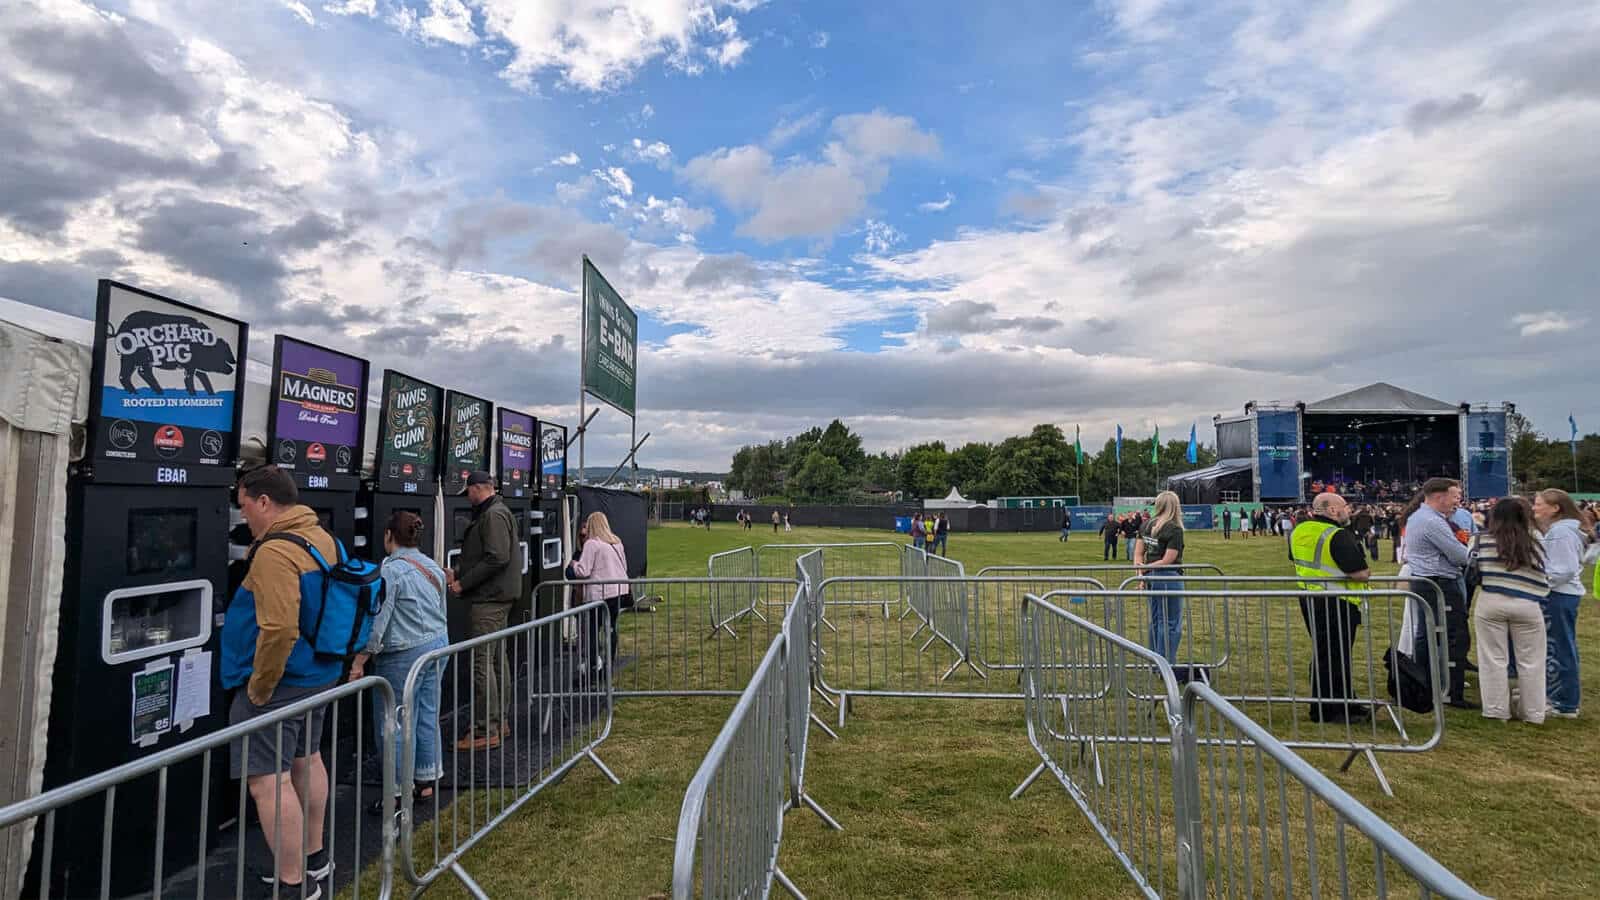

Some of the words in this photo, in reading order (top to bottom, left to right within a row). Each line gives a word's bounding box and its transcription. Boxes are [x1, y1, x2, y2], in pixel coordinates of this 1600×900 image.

[116, 324, 217, 355] ORCHARD
[600, 314, 633, 369] E-BAR
[150, 343, 192, 366] PIG
[124, 398, 165, 407] ROOTED
[167, 398, 177, 407] IN
[178, 398, 224, 407] SOMERSET
[283, 377, 355, 408] MAGNERS
[397, 388, 427, 409] INNIS
[407, 410, 416, 426] &
[457, 403, 480, 423] INNIS
[394, 427, 425, 449] GUNN
[455, 437, 479, 458] GUNN
[502, 431, 531, 449] MAGNERS
[157, 467, 187, 483] EBAR
[308, 475, 329, 489] EBAR
